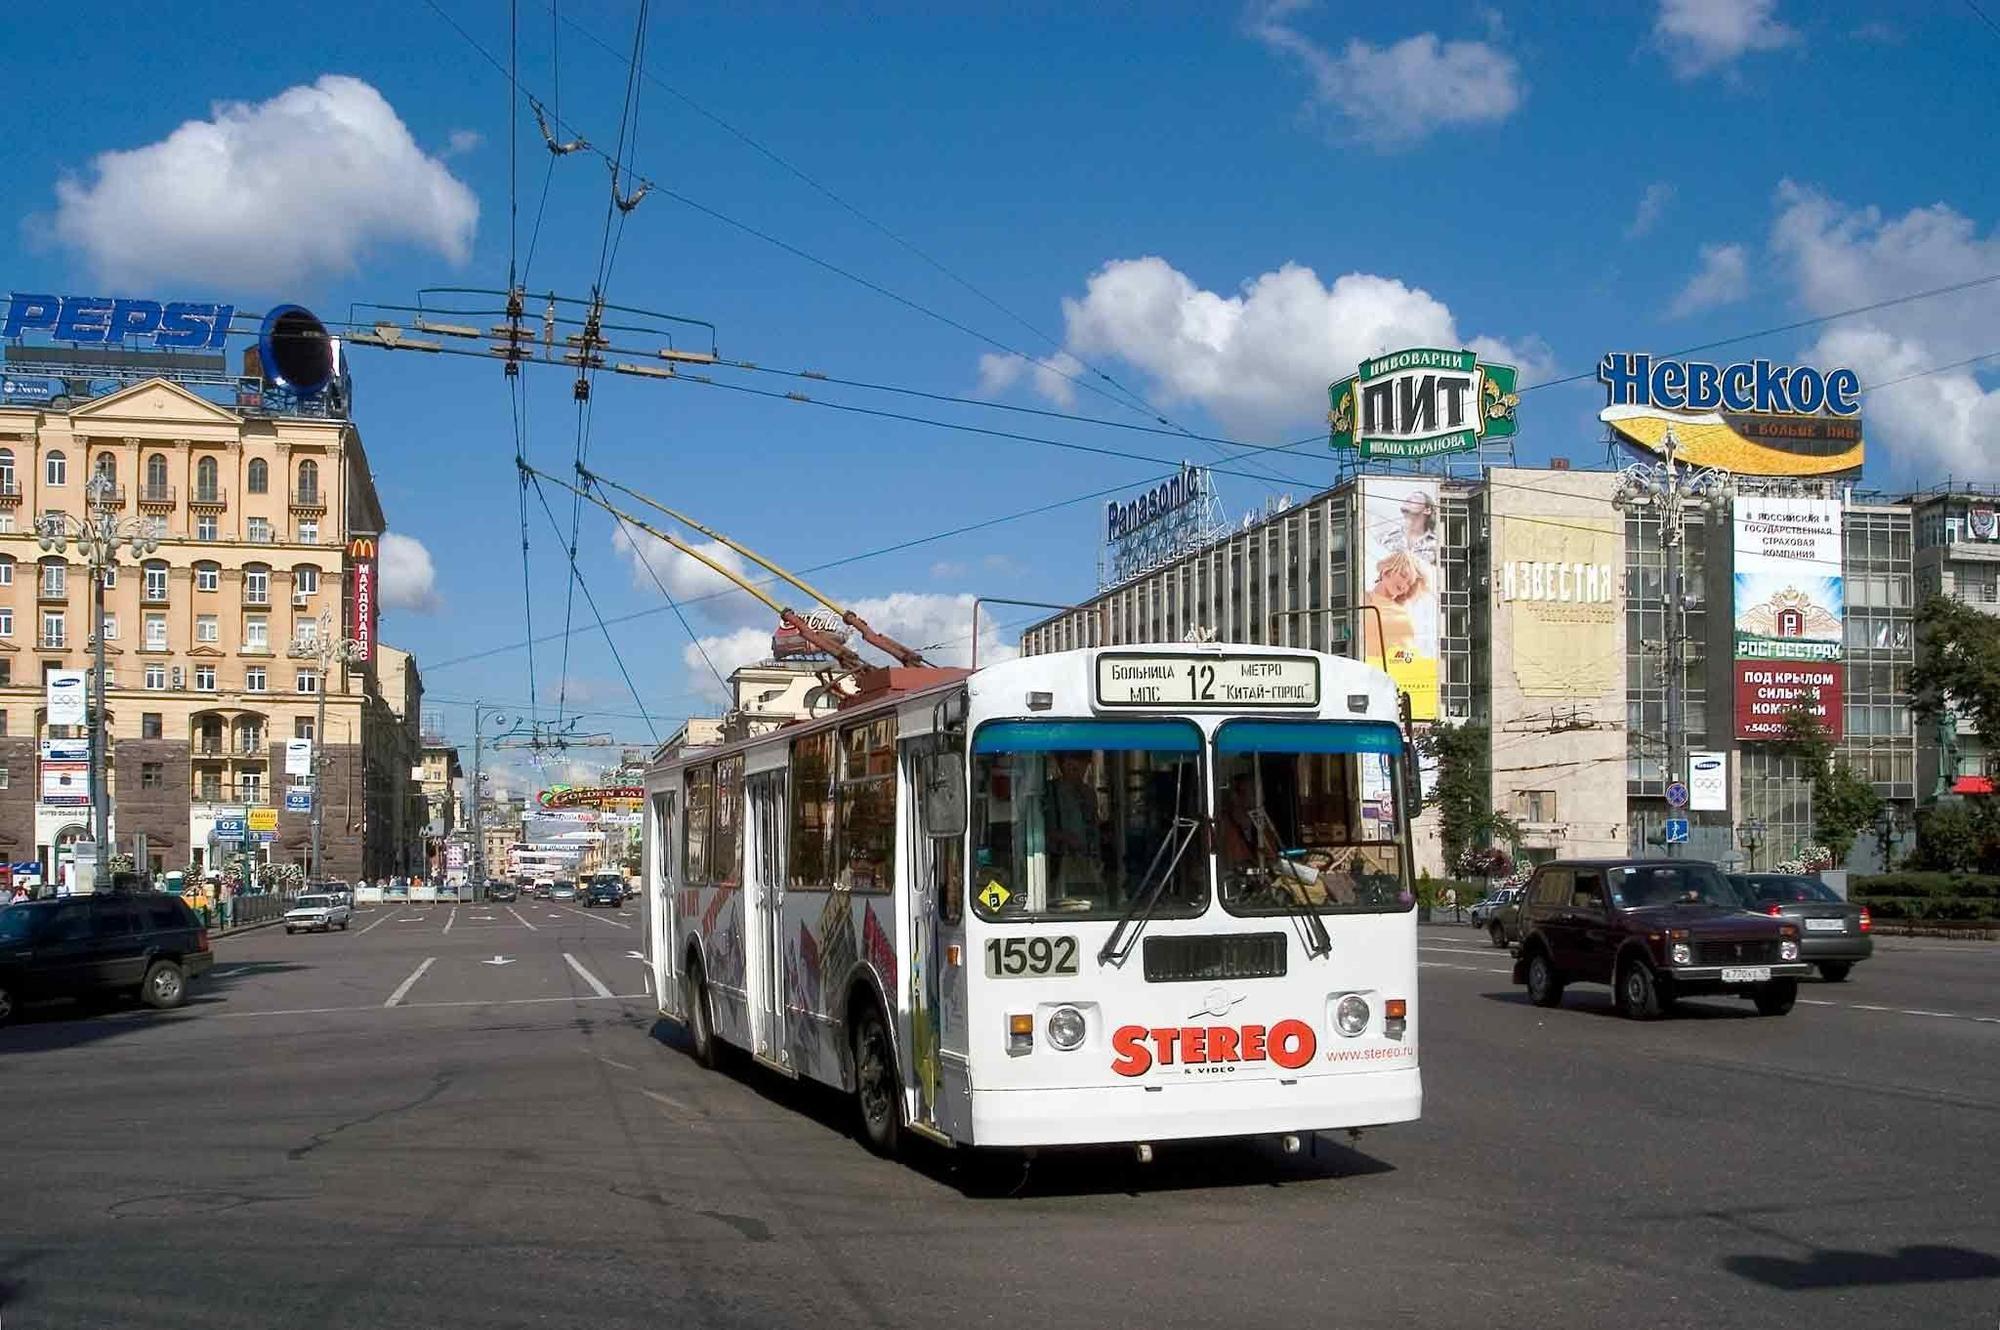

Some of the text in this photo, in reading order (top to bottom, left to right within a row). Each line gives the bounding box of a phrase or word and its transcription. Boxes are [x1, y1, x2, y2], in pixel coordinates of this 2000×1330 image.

[2, 292, 235, 350] PEPSI
[1370, 352, 1463, 377] ПИВОВАРНИ
[1600, 353, 1862, 416] Невское
[1362, 375, 1471, 437] ПИТ
[1826, 426, 1861, 439] ПИВ
[1108, 460, 1199, 542] Panasonic
[1758, 513, 1820, 523] РОССИЙСКАЯ
[1744, 524, 1832, 535] ГОСУДАРСТВЕННАЯ
[1762, 537, 1815, 546] СТРАХОВАЯ
[1762, 549, 1815, 559] КОМПАНИЯ
[1503, 561, 1613, 603] ИЗВЕСТИЯ
[358, 564, 369, 661] МАКДОНАЛДС
[1737, 641, 1841, 659] РОСГОССТРАХ
[1241, 663, 1282, 677] МЕТРО
[1744, 671, 1834, 685] ПОД КРЫЛОМ
[1187, 664, 1216, 701] 12
[1130, 686, 1161, 703] МПС
[291, 796, 305, 804] 02
[221, 821, 239, 830] 02
[988, 936, 1078, 975] 1592
[1111, 1019, 1317, 1077] STEREO
[1325, 1046, 1414, 1063] www.stereo.ru
[1198, 1066, 1236, 1075] VIDEO
